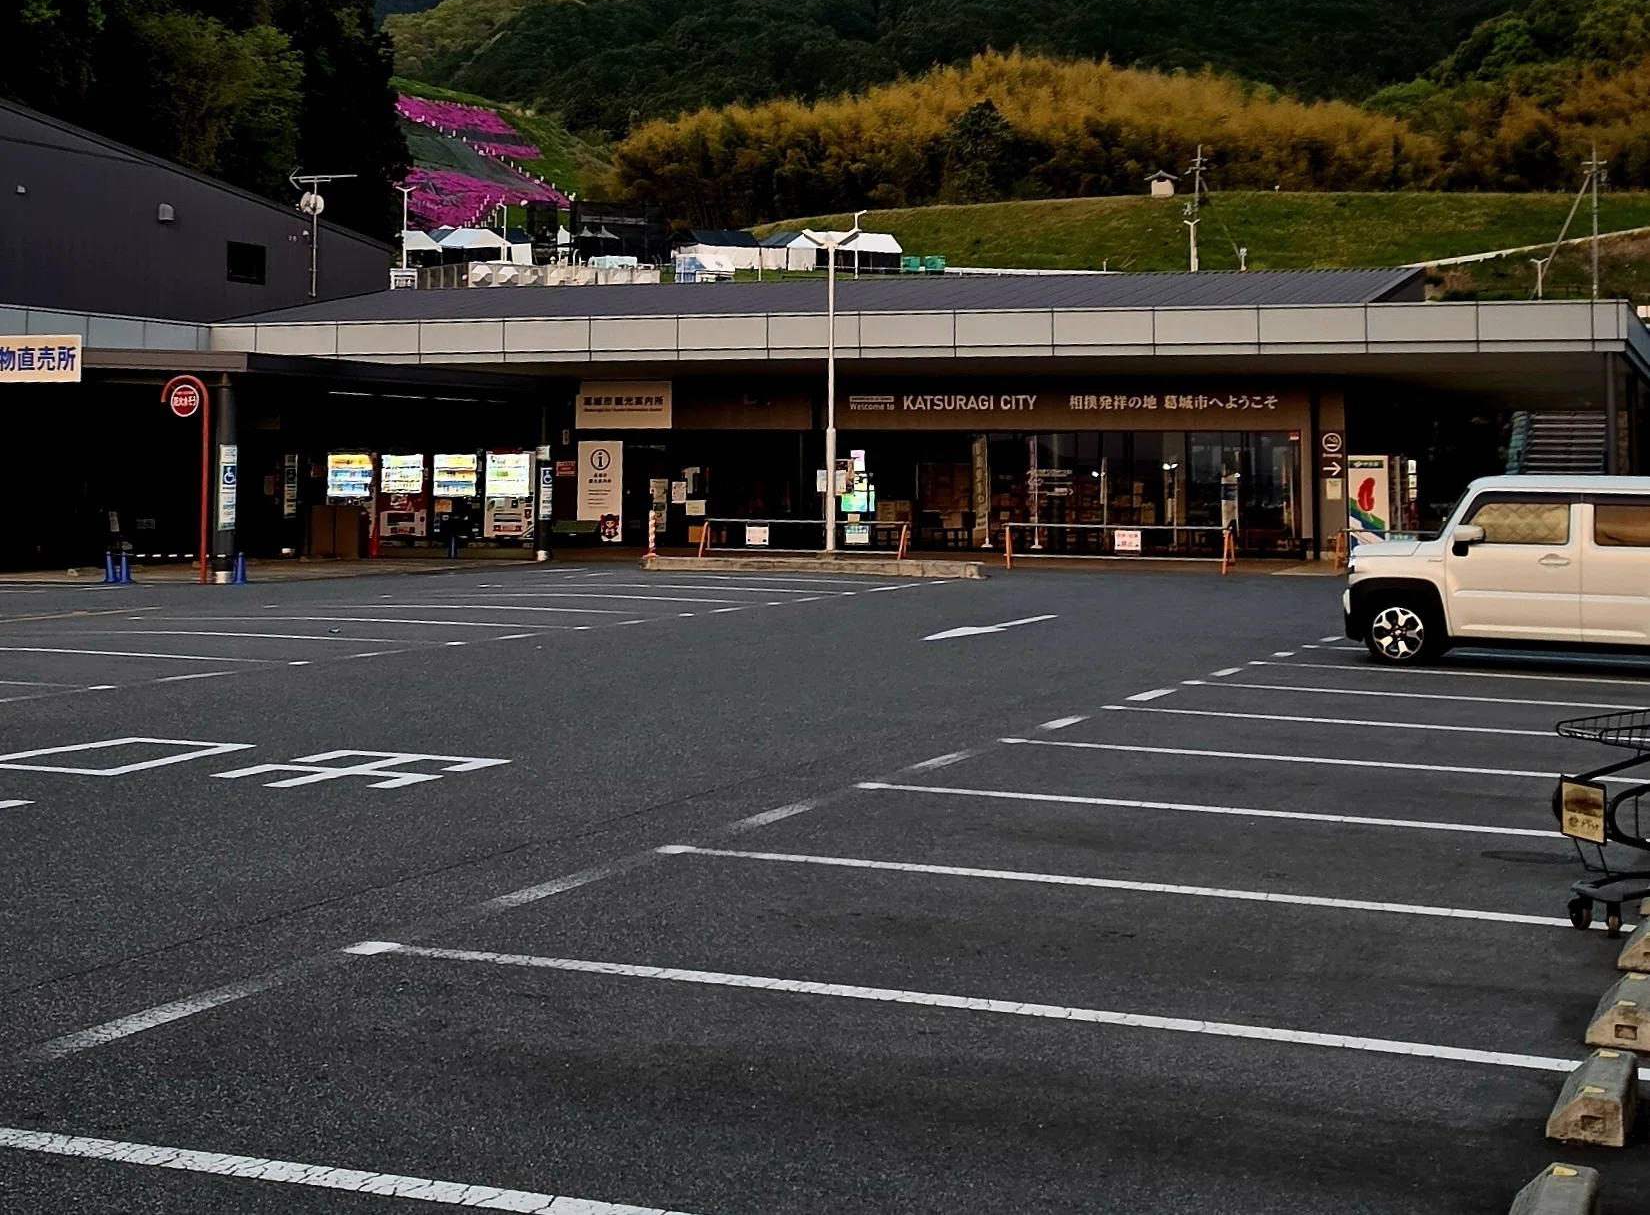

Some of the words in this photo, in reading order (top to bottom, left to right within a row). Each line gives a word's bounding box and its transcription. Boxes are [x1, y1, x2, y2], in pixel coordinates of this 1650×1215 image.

[0, 345, 76, 371] 物直売所
[850, 402, 885, 411] Welcome
[886, 402, 895, 411] to
[903, 395, 994, 410] KATSURAGI
[1000, 395, 1037, 410] CITY
[1069, 394, 1158, 410] 相撲発祥の地
[1163, 394, 1279, 410] 葛城市へようこそ
